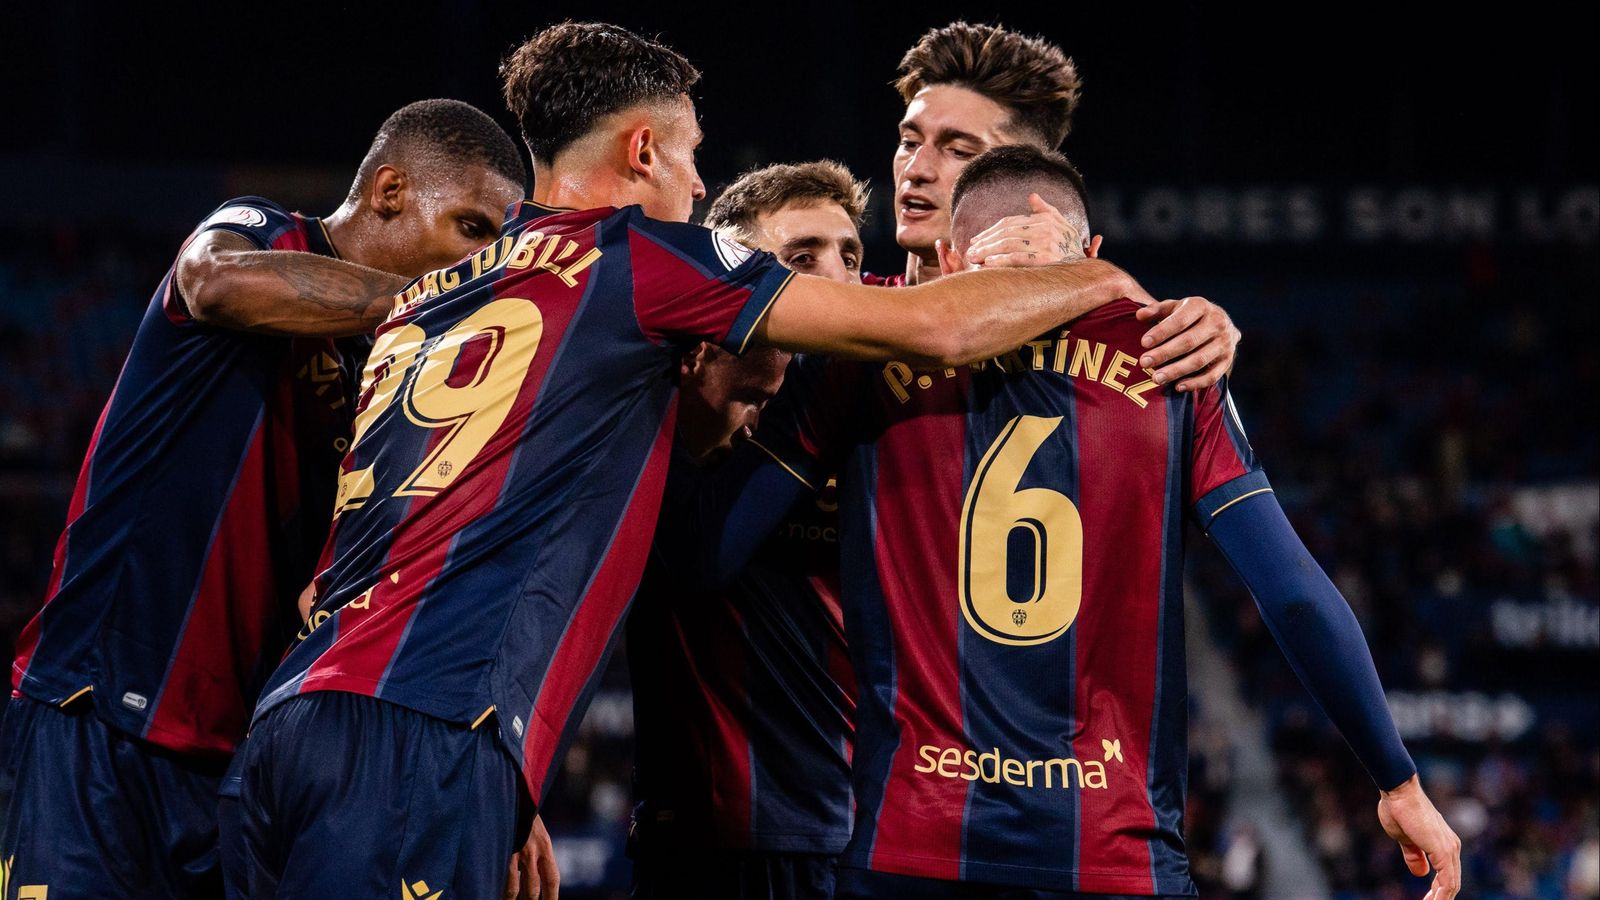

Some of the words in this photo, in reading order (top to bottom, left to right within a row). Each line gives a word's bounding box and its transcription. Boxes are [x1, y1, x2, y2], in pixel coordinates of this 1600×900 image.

[1347, 186, 1497, 242] SON
[944, 330, 1160, 409] TÍNEZ
[333, 297, 544, 523] 29
[958, 414, 1084, 647] 6
[914, 744, 1108, 790] sesderma
